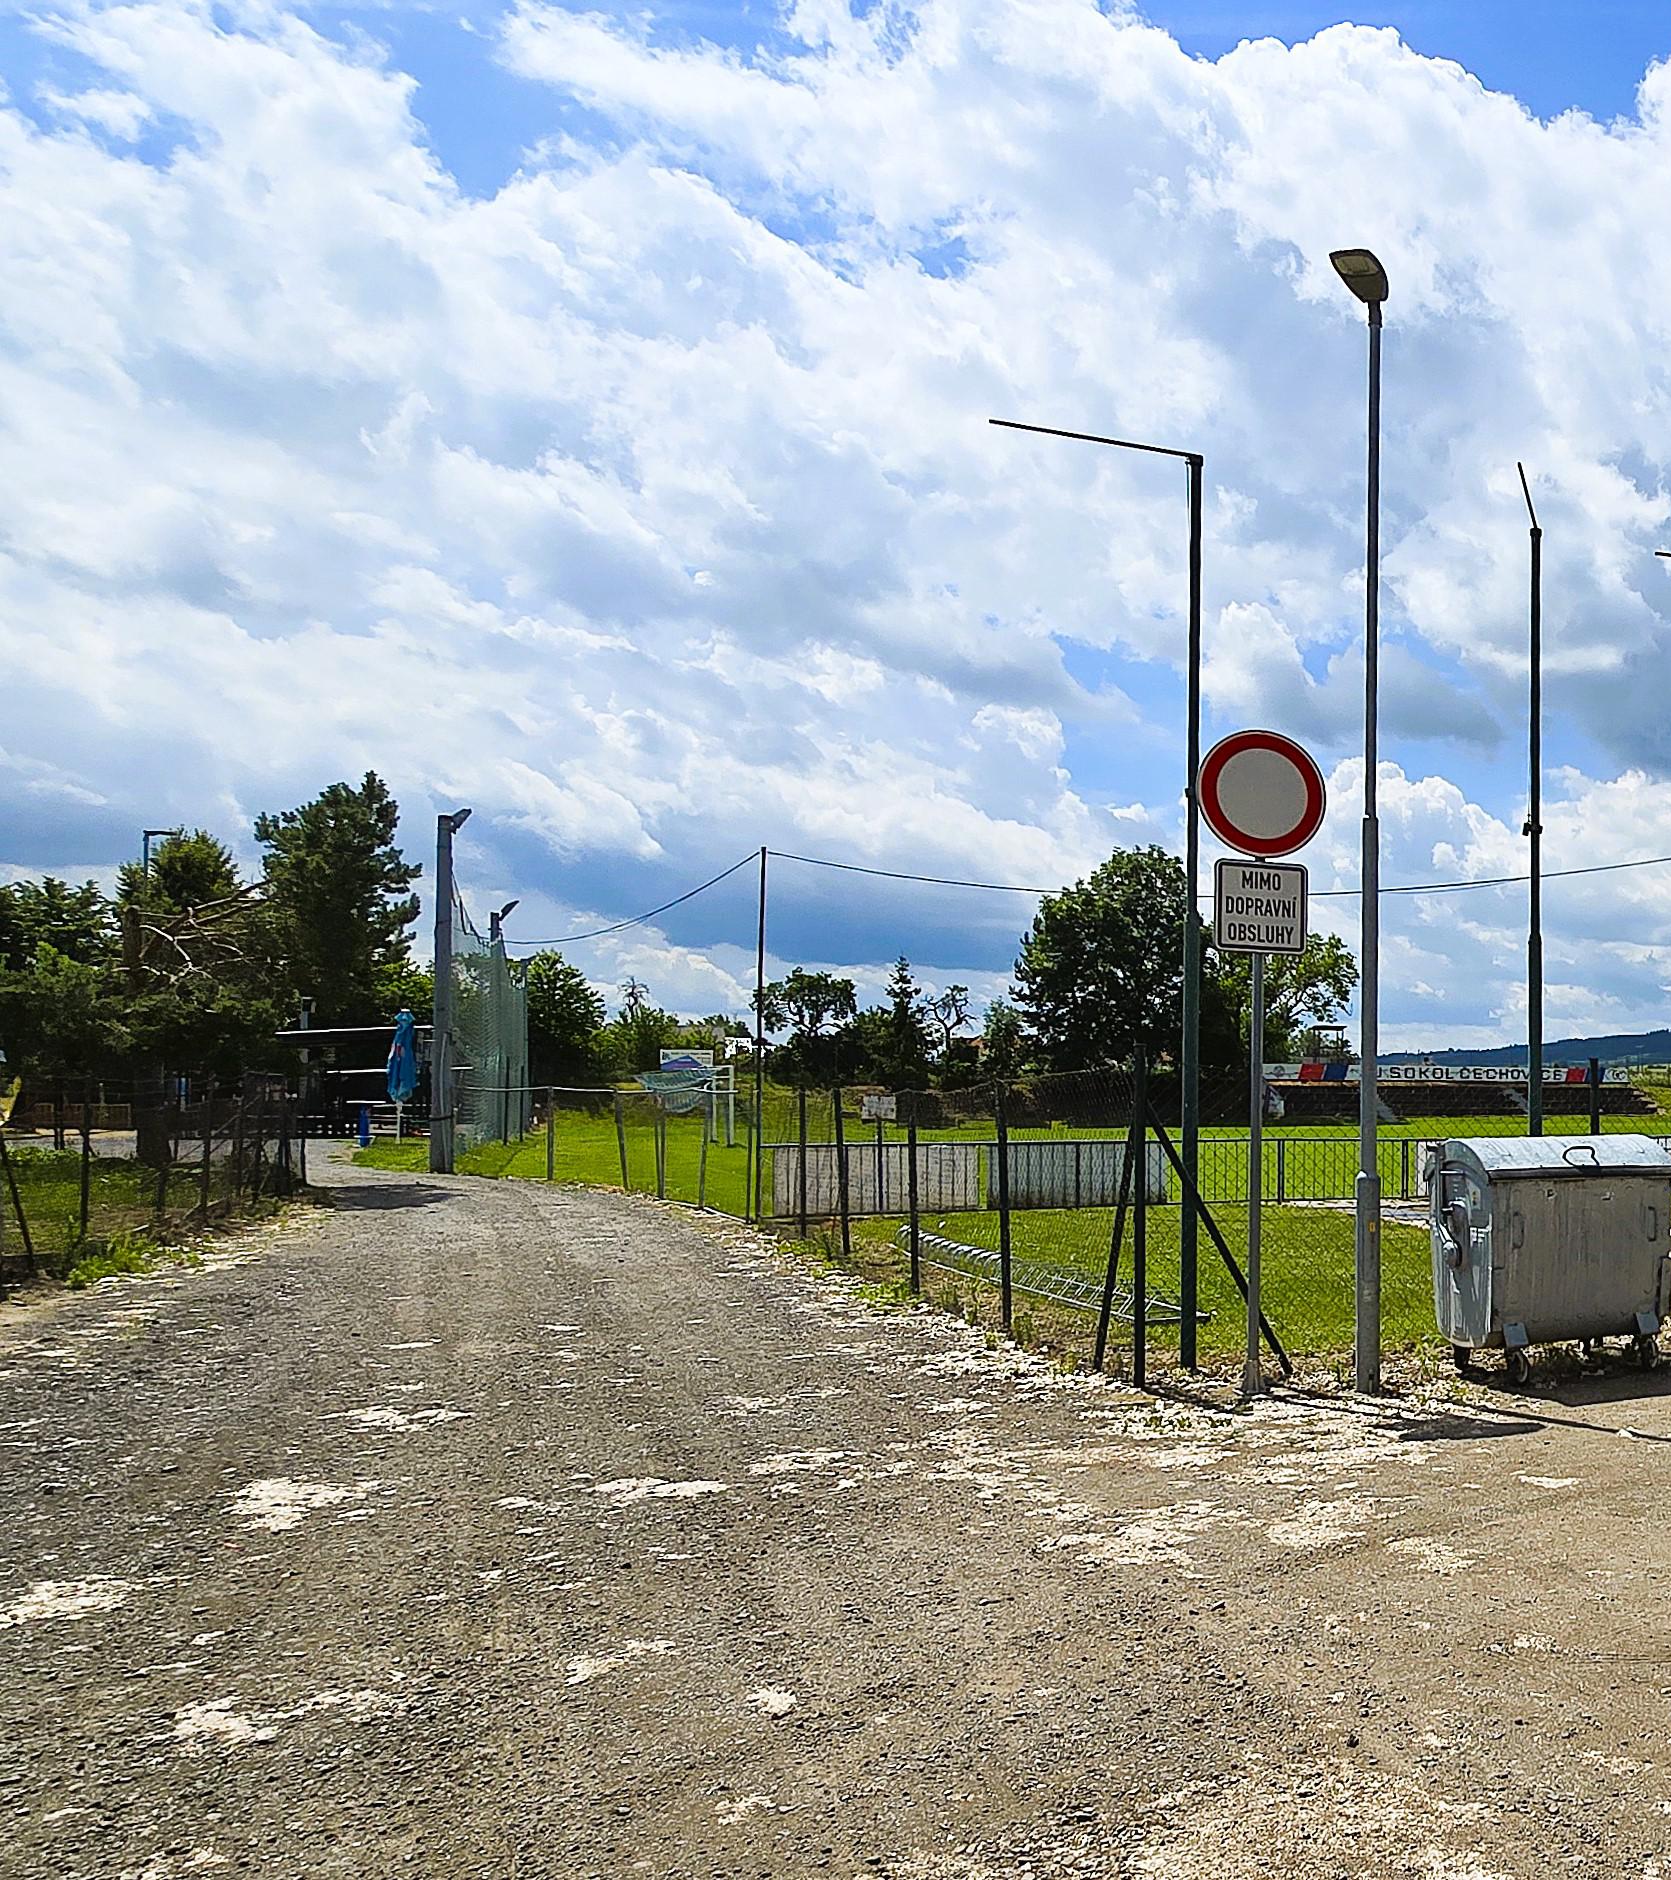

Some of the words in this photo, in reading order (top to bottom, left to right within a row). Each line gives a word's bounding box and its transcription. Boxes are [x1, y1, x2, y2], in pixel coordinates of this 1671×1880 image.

[1241, 870, 1281, 891] MIMO
[1225, 895, 1297, 919] DOPRAVNÍ
[1227, 922, 1294, 945] OBSLUHY
[1389, 1066, 1454, 1080] SOKOL
[1459, 1065, 1563, 1081] ČECHOVCE
